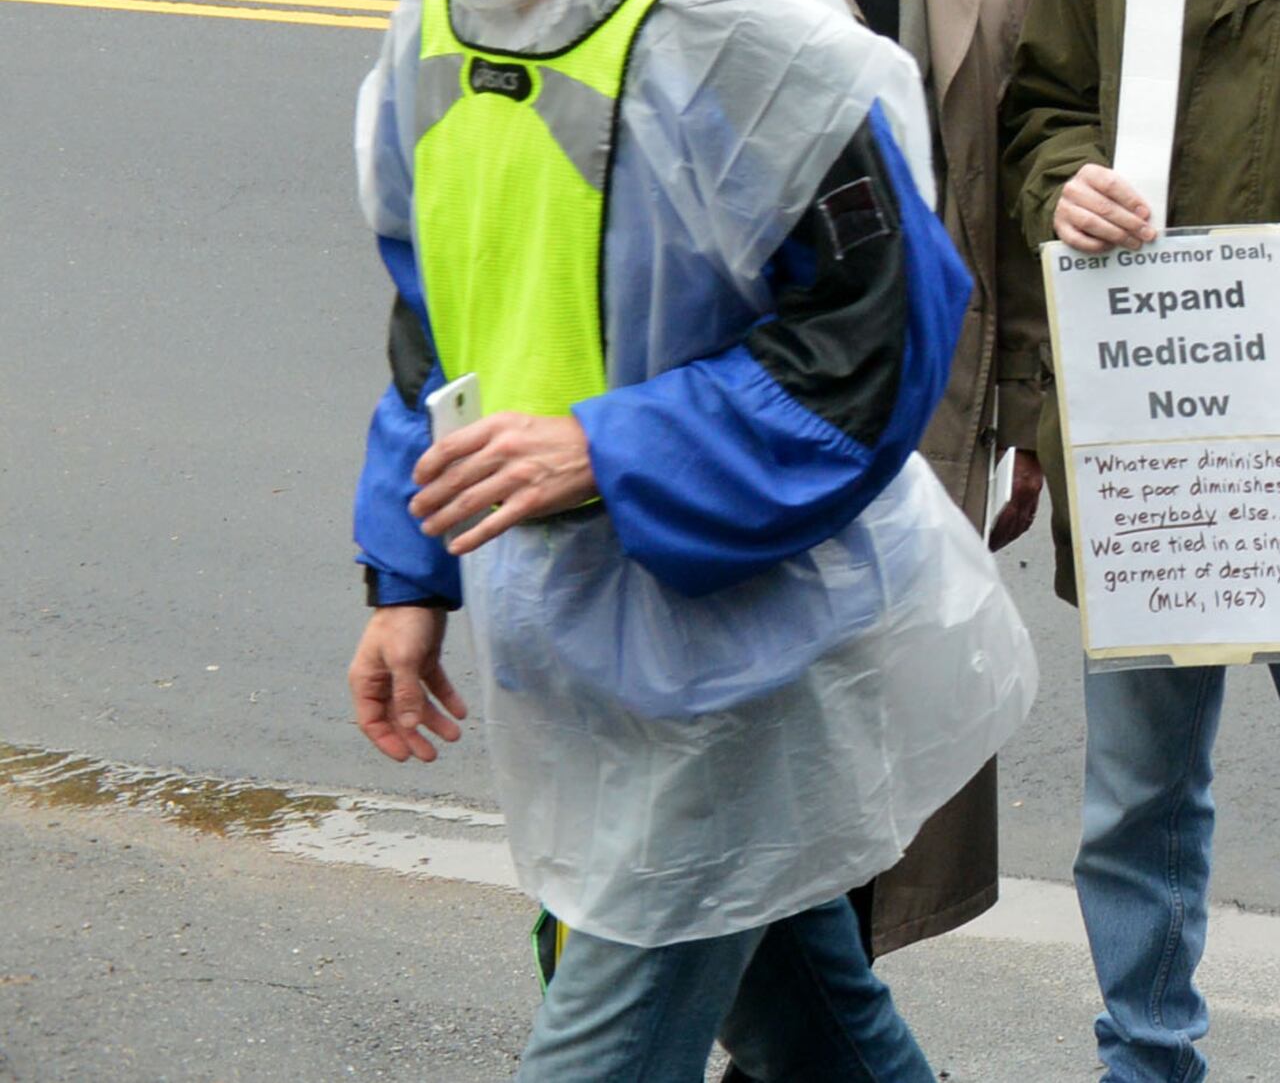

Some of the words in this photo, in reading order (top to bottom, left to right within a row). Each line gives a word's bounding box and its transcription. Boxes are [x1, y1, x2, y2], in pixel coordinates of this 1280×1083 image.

[1058, 254, 1109, 272] Dear
[1117, 247, 1214, 268] Governor
[1220, 243, 1273, 262] Deal,
[1107, 280, 1246, 319] Expand
[1097, 333, 1267, 369] Medicaid
[1148, 390, 1230, 419] Now
[1084, 453, 1189, 475] "Whatever
[1098, 482, 1135, 500] the
[1142, 484, 1181, 503] poor
[1114, 505, 1218, 530] everybody
[1091, 538, 1125, 557] We
[1131, 541, 1161, 554] are
[1168, 536, 1207, 555] tied
[1212, 537, 1229, 552] in
[1235, 539, 1249, 551] a
[1103, 565, 1187, 592] garment
[1195, 562, 1211, 578] of
[1149, 586, 1207, 613] (MLK,
[1214, 586, 1267, 609] 1967)
